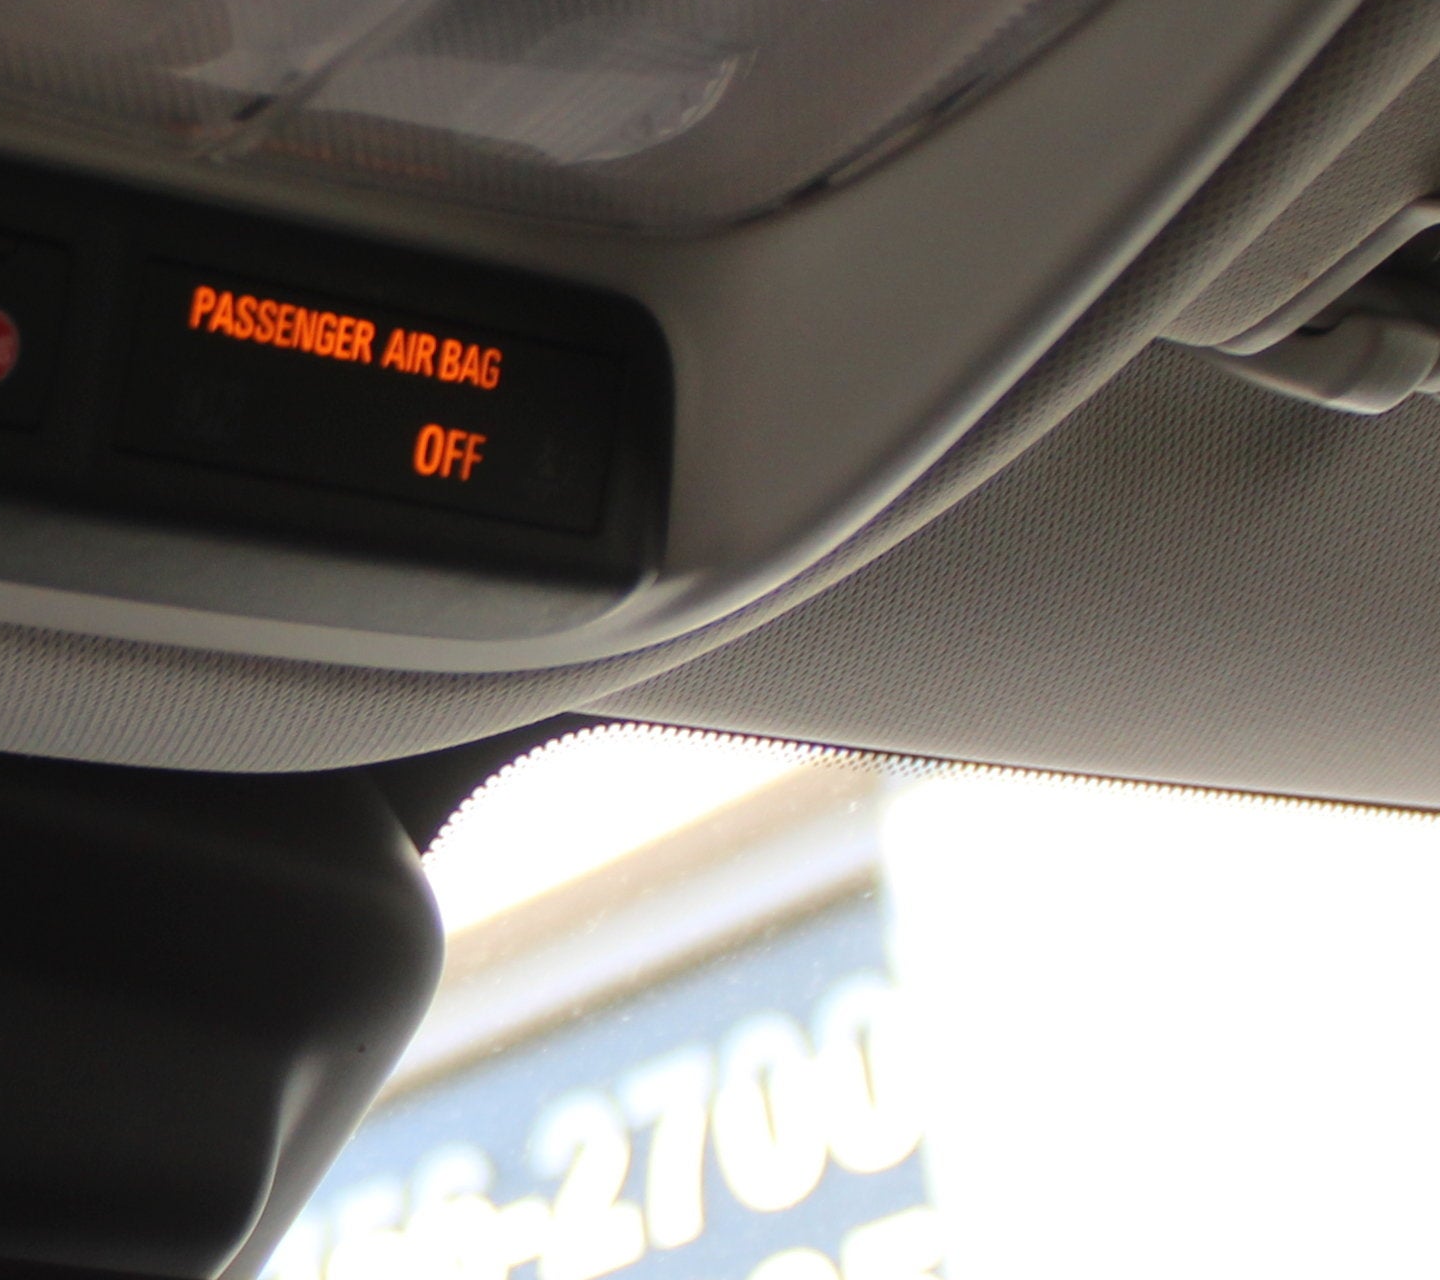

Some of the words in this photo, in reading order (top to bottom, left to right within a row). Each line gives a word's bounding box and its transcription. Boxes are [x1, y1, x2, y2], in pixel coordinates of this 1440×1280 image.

[188, 284, 376, 364] PASSENGER
[381, 327, 437, 377] AIR
[438, 337, 503, 390] BAG
[413, 423, 488, 482] OFF
